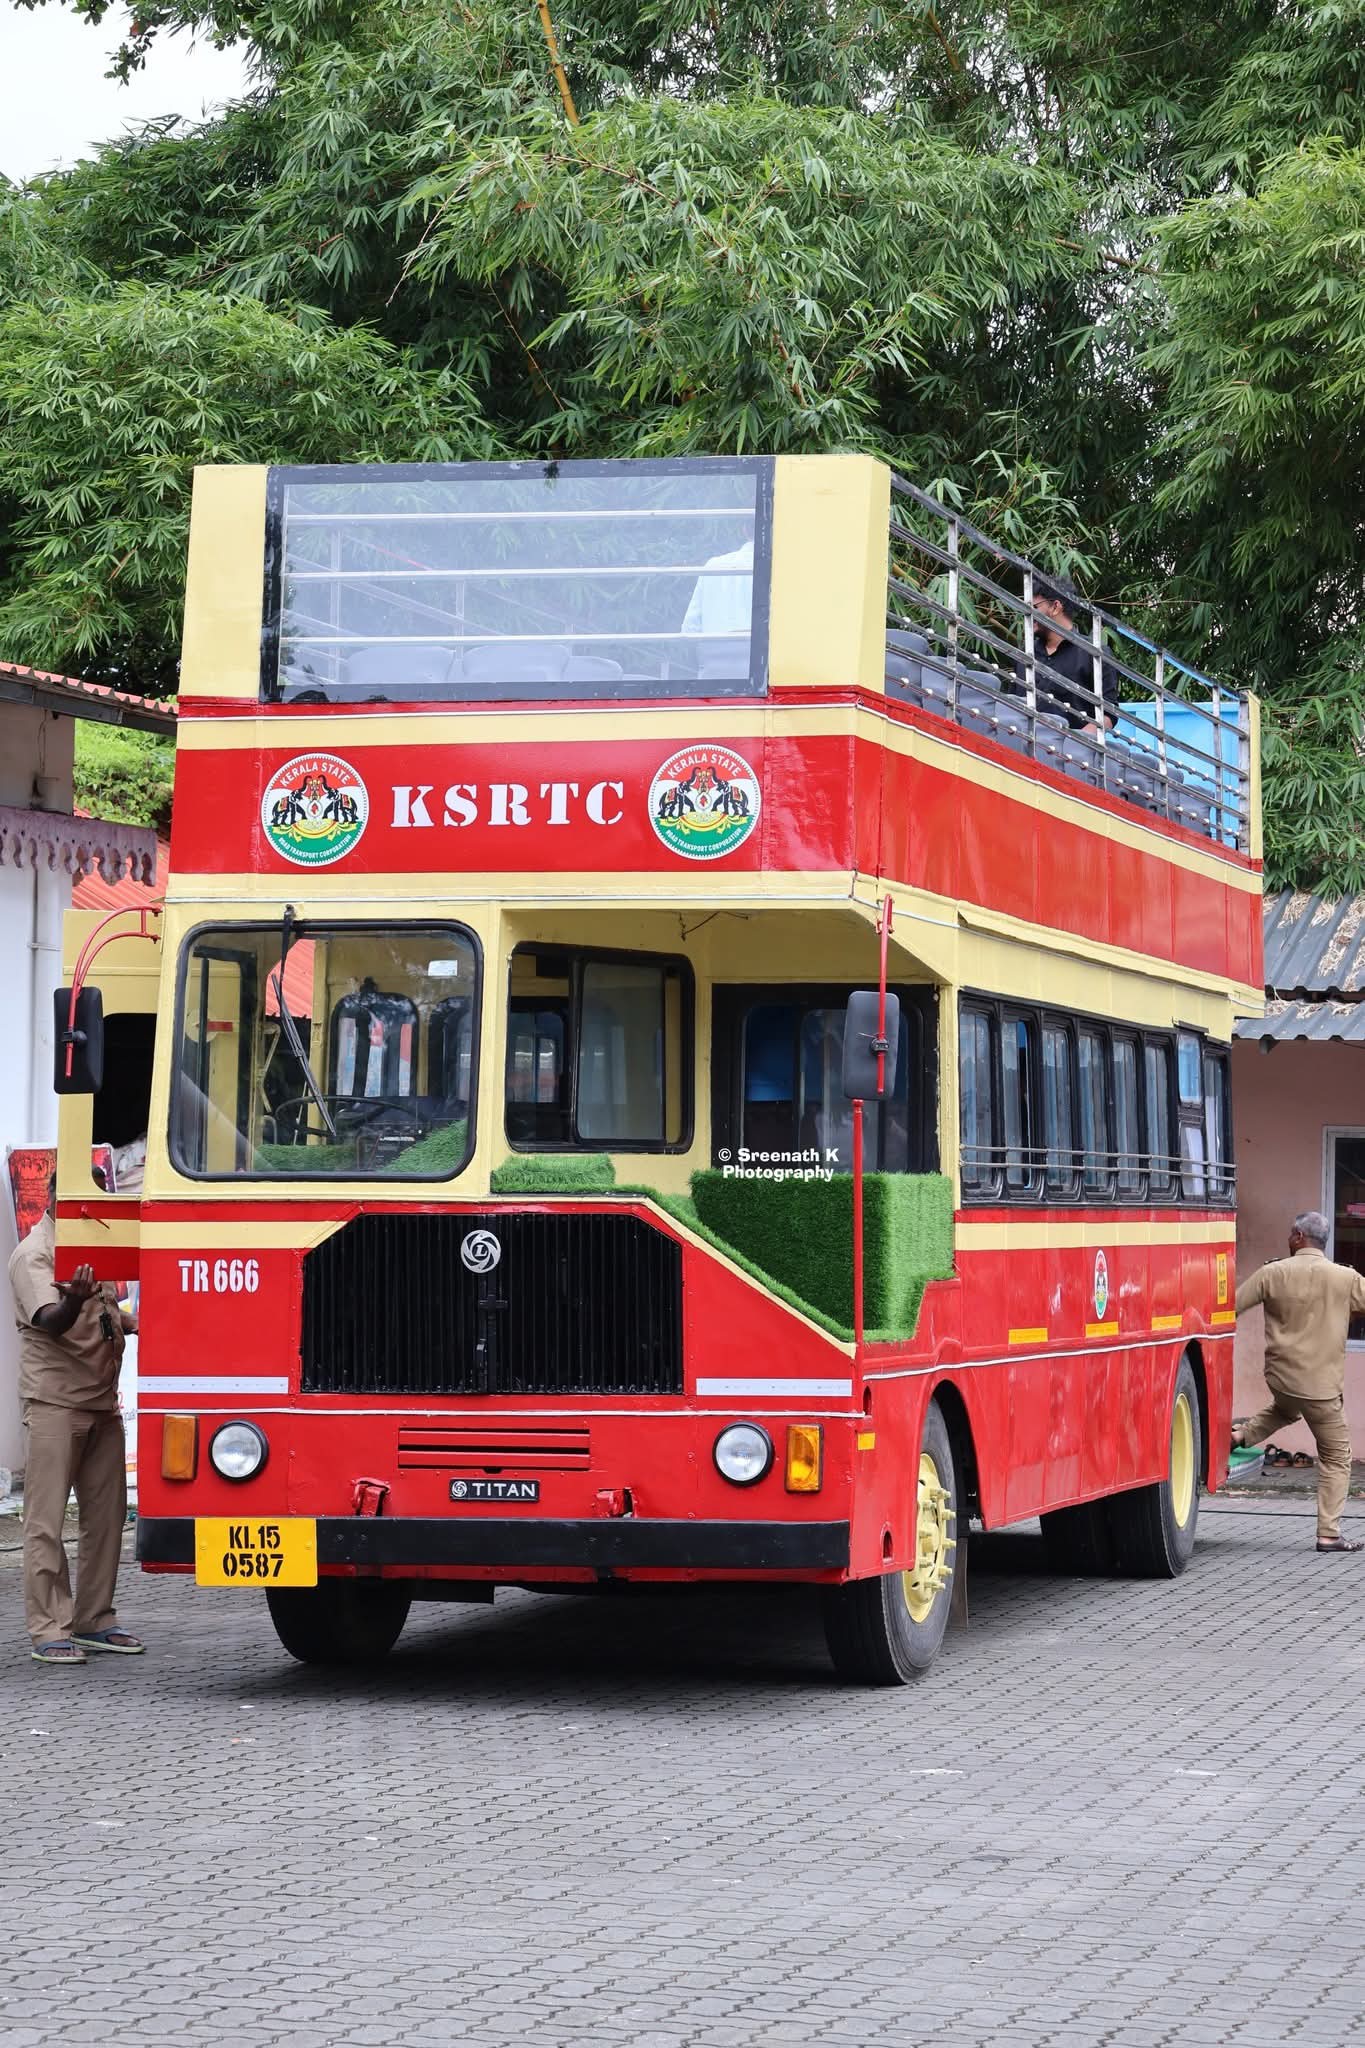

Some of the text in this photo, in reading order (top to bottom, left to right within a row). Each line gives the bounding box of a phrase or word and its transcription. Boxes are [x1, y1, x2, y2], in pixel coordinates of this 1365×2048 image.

[280, 762, 351, 787] KERALA STATE
[667, 753, 742, 778] KERALA STATE
[390, 781, 624, 828] KSRTC
[278, 834, 352, 859] ROAD TRANSPORT CORPORATION
[665, 827, 743, 852] ROAD TRANSPORT CORPORATION
[178, 1258, 260, 1293] TR 666
[471, 1482, 535, 1497] TITAN
[222, 1552, 284, 1578] 0587
